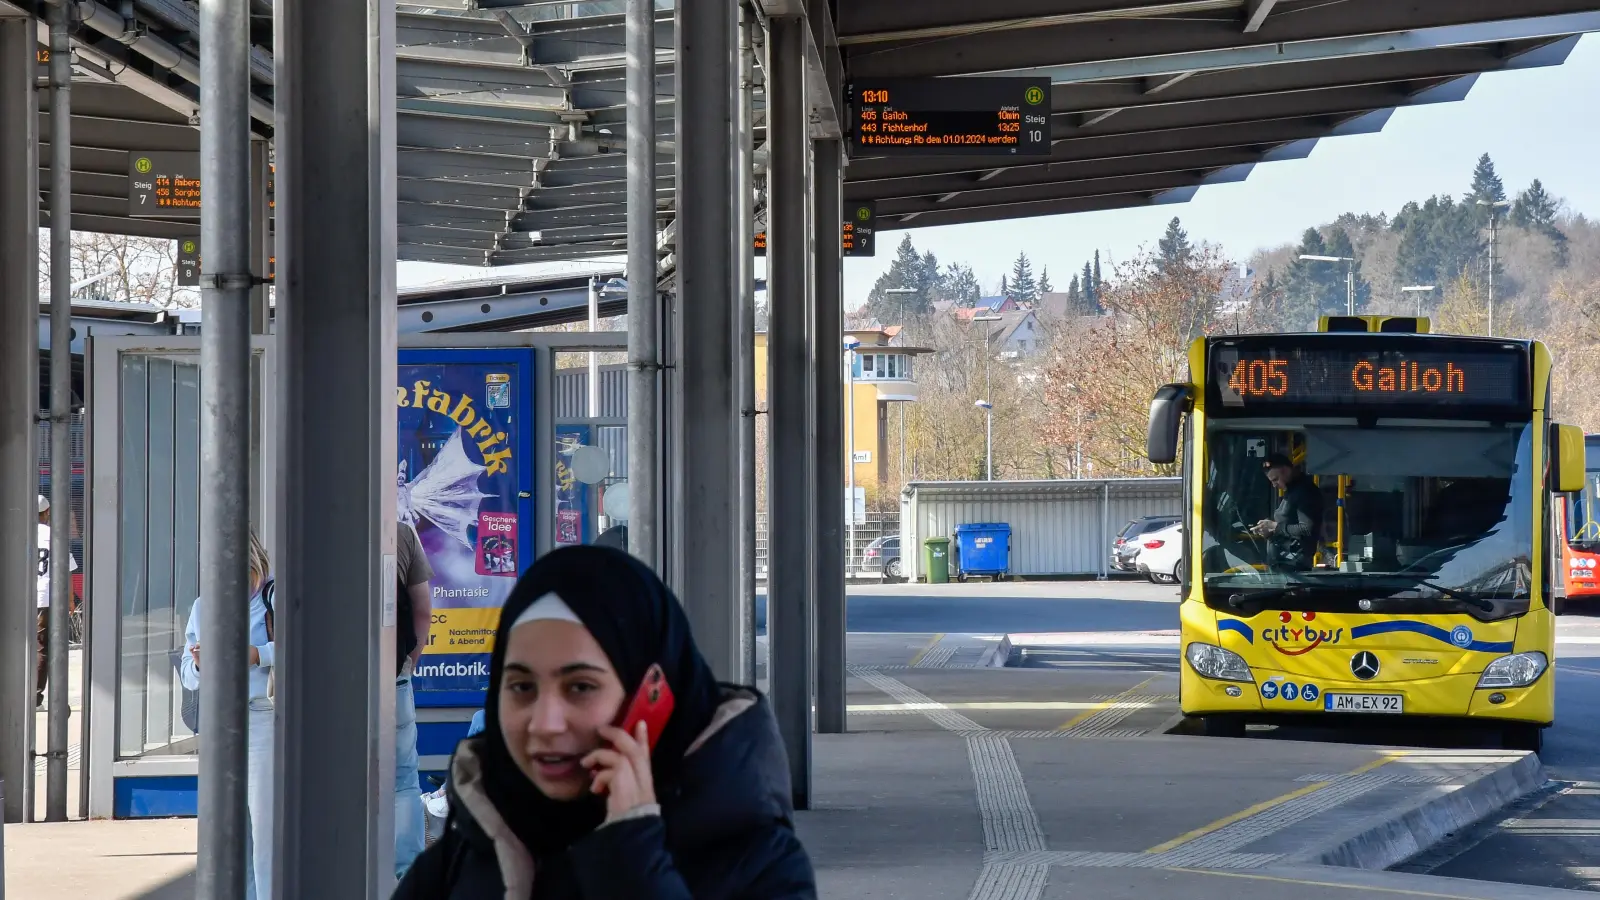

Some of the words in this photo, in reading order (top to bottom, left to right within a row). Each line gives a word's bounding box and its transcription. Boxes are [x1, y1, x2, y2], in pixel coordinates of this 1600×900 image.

[862, 90, 888, 103] 13:10
[861, 111, 877, 120] 405
[882, 111, 908, 120] Gailoh
[998, 111, 1020, 120] 10min
[1025, 115, 1046, 124] Steig
[861, 123, 877, 132] 443
[882, 122, 928, 132] Fichtenhof
[998, 122, 1020, 132] 13:25
[875, 135, 912, 144] Achtung:
[913, 134, 925, 144] Ab
[926, 134, 942, 144] dem
[943, 135, 986, 144] 01.01.2024
[987, 135, 1017, 144] werden
[1029, 130, 1042, 143] 10
[134, 181, 152, 191] Steig
[156, 178, 170, 186] 414
[139, 194, 147, 205] 7
[856, 227, 872, 235] Steig
[861, 238, 867, 248] 9
[181, 259, 196, 267] Steig
[186, 269, 192, 278] 8
[1229, 359, 1289, 397] 405
[1352, 360, 1466, 393] Gailoh
[482, 515, 517, 524] Geschenk
[488, 522, 512, 532] Idee
[433, 586, 489, 599] Phantasie
[457, 637, 485, 645] Abend
[1336, 697, 1354, 709] AM
[1362, 697, 1378, 710] EX
[1382, 697, 1398, 710] 92
